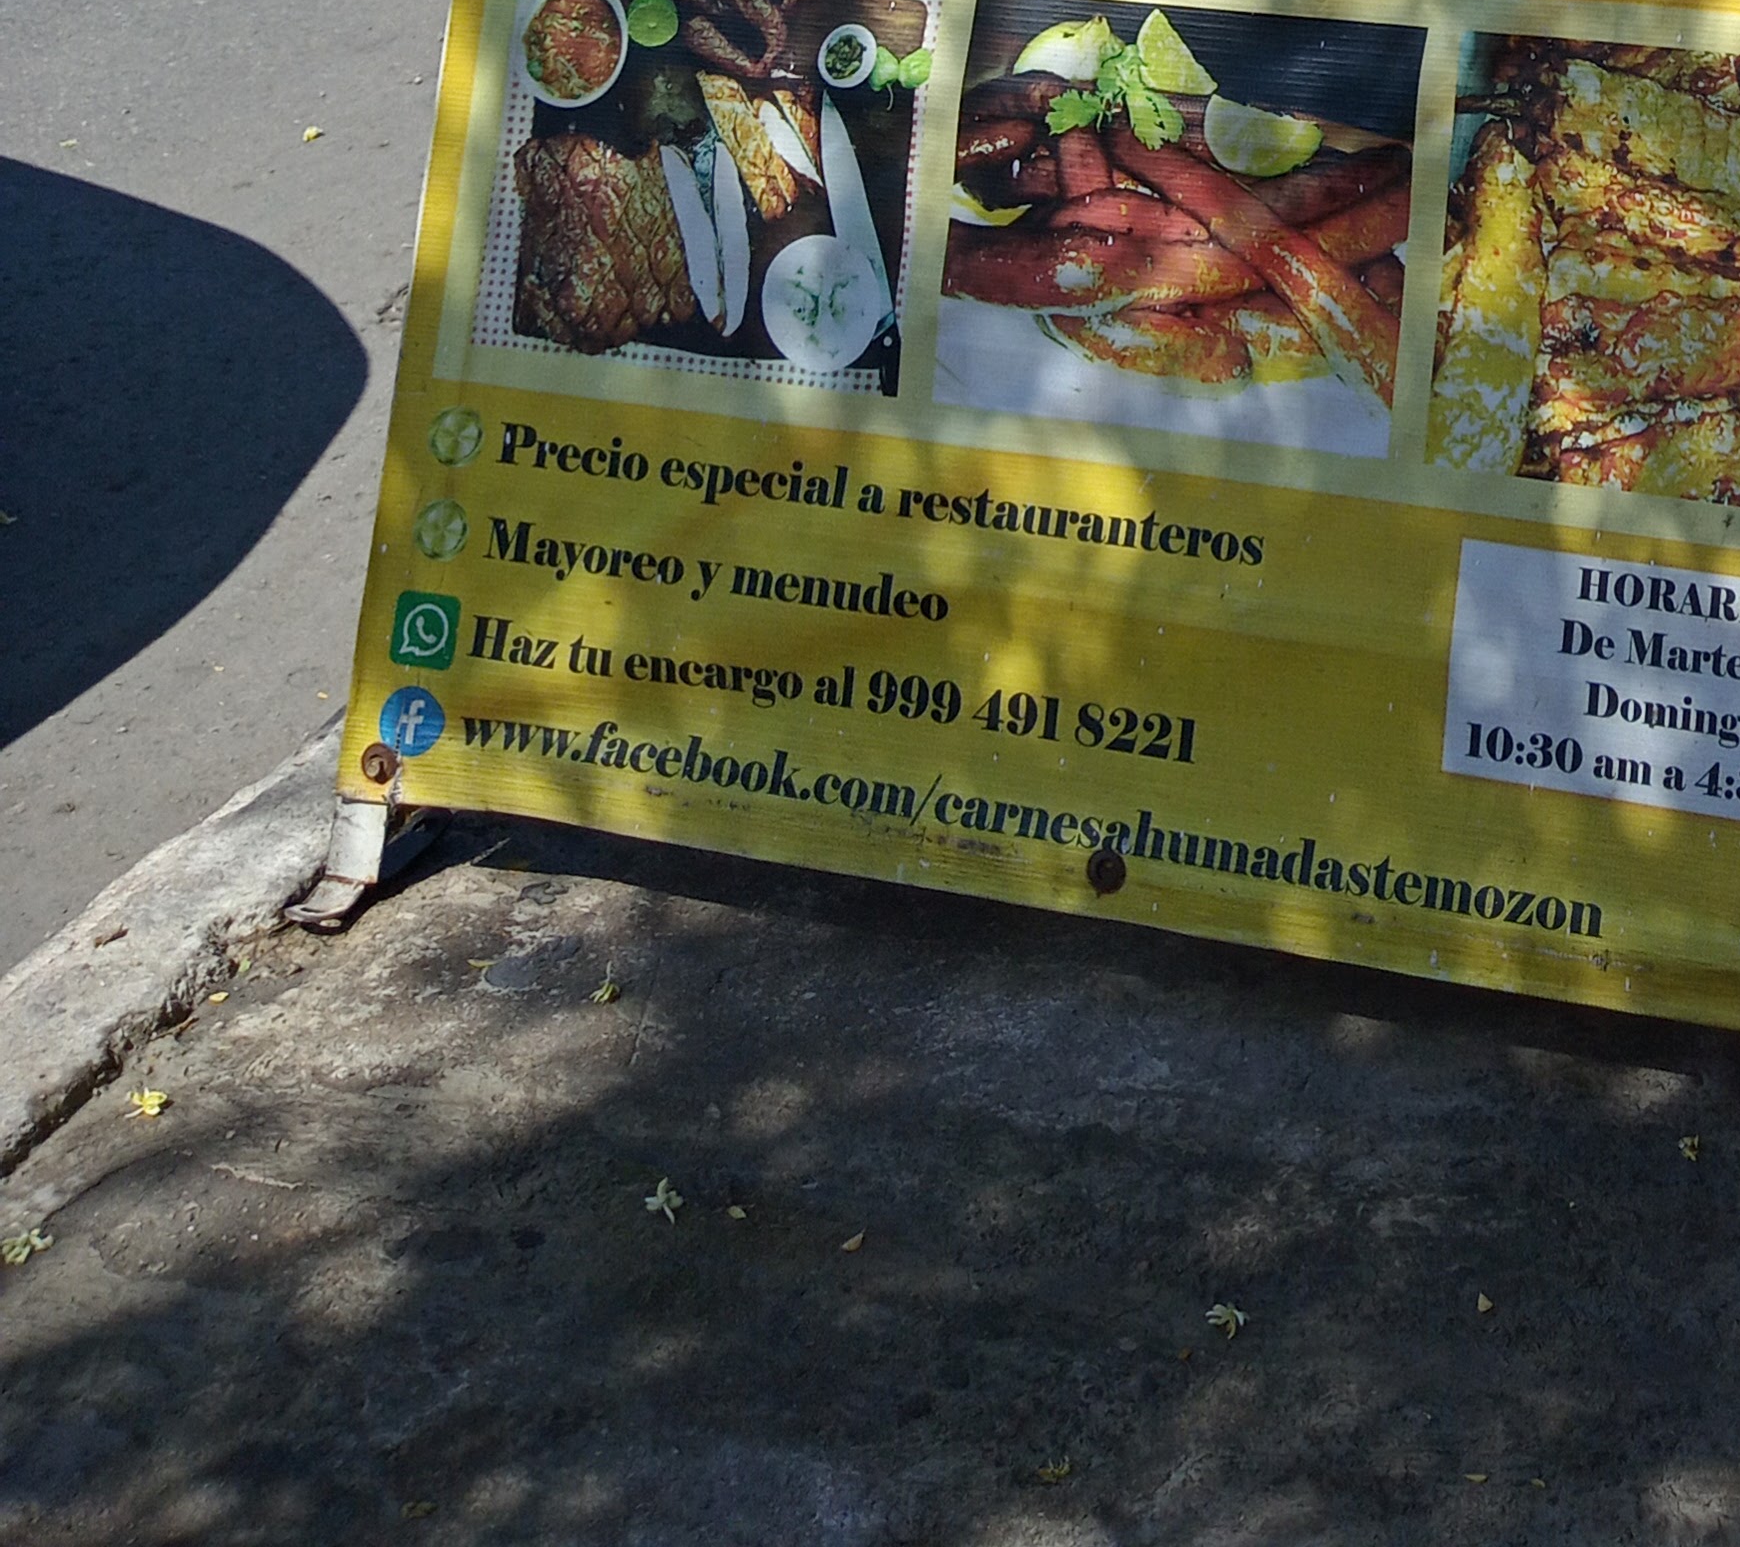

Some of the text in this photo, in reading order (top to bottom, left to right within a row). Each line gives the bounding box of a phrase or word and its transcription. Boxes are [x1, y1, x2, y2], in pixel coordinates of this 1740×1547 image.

[495, 422, 1264, 566] Precio especial a restauranteros
[482, 516, 949, 622] Mayoreo y menudeo
[466, 615, 1197, 764] Haz tu encargo al 999 491 8221
[1558, 619, 1615, 662] De
[1465, 722, 1583, 774] 10:30
[1593, 754, 1652, 787] am
[1663, 764, 1686, 792] a
[461, 715, 1603, 938] www.facebook.com/carnesahumadastemozon
